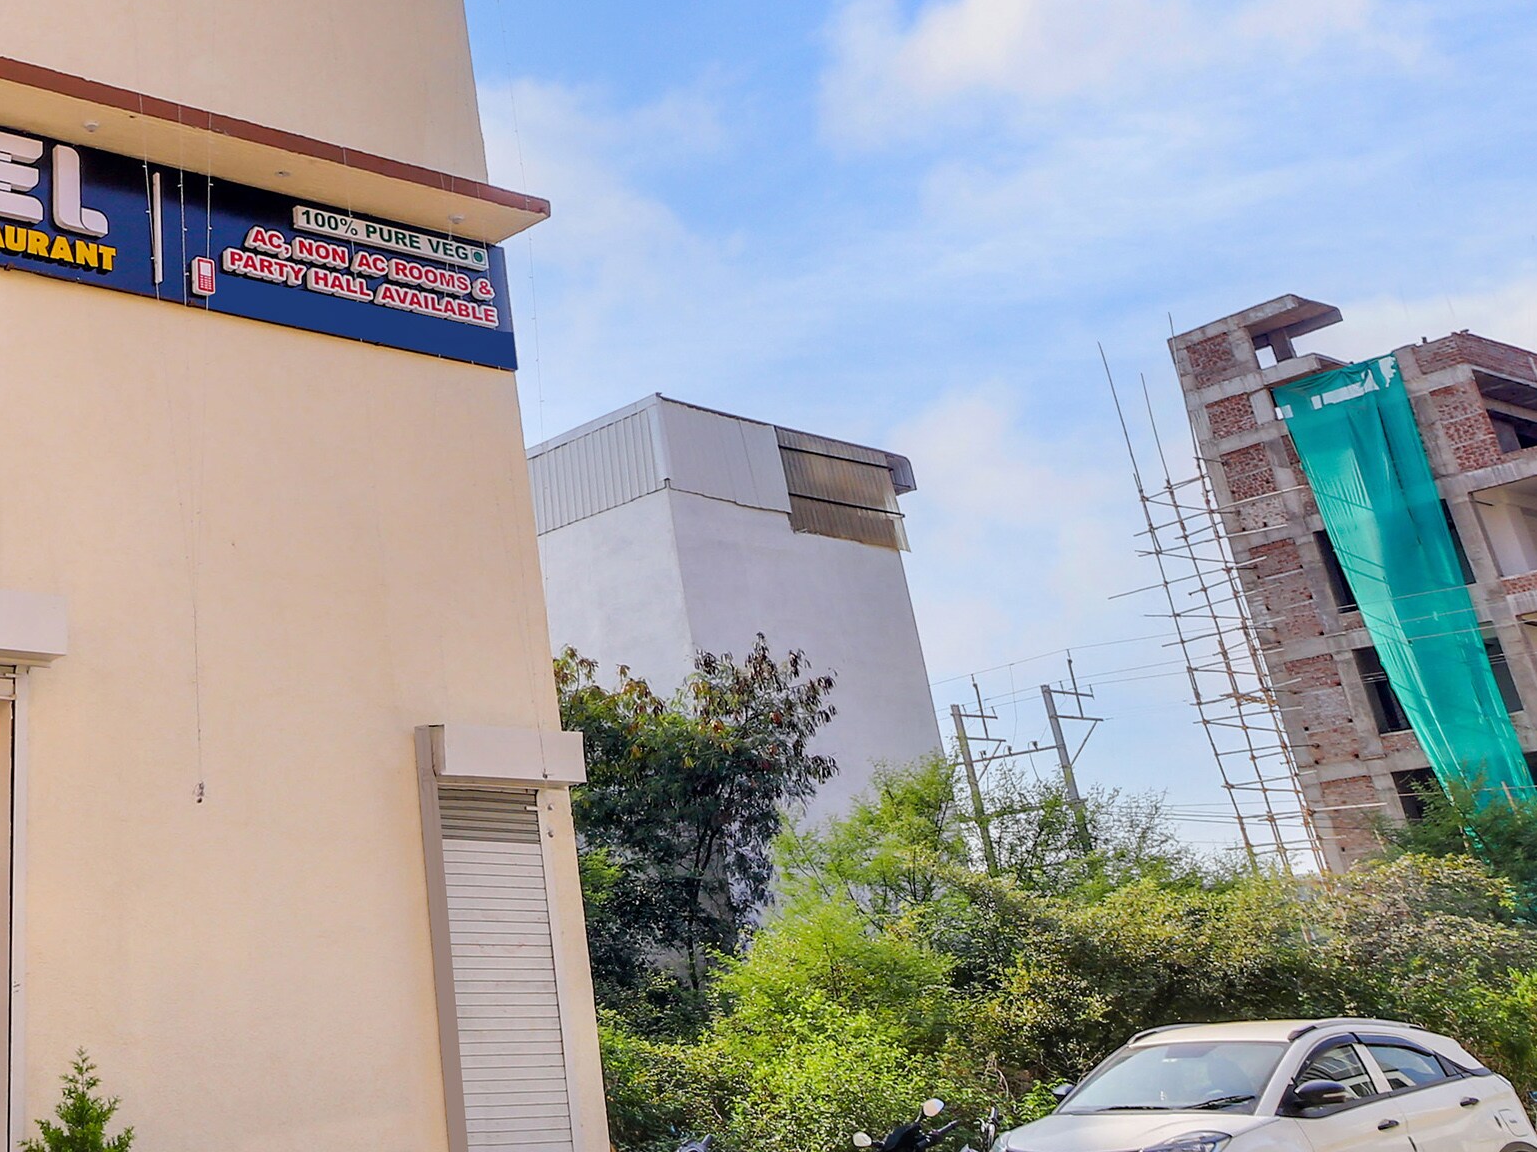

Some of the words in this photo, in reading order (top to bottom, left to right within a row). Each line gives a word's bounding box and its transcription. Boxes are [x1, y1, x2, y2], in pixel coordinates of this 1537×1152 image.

[249, 228, 291, 258] AC,
[295, 239, 349, 268] NON
[355, 250, 389, 276] AC
[391, 260, 472, 294] ROOMS
[476, 277, 495, 299] &
[300, 208, 359, 237] 100%
[364, 223, 421, 250] PURE
[427, 238, 469, 261] VEG
[227, 250, 306, 285] PARTY
[311, 268, 374, 300] HALL
[379, 286, 499, 326] AVAILABLE
